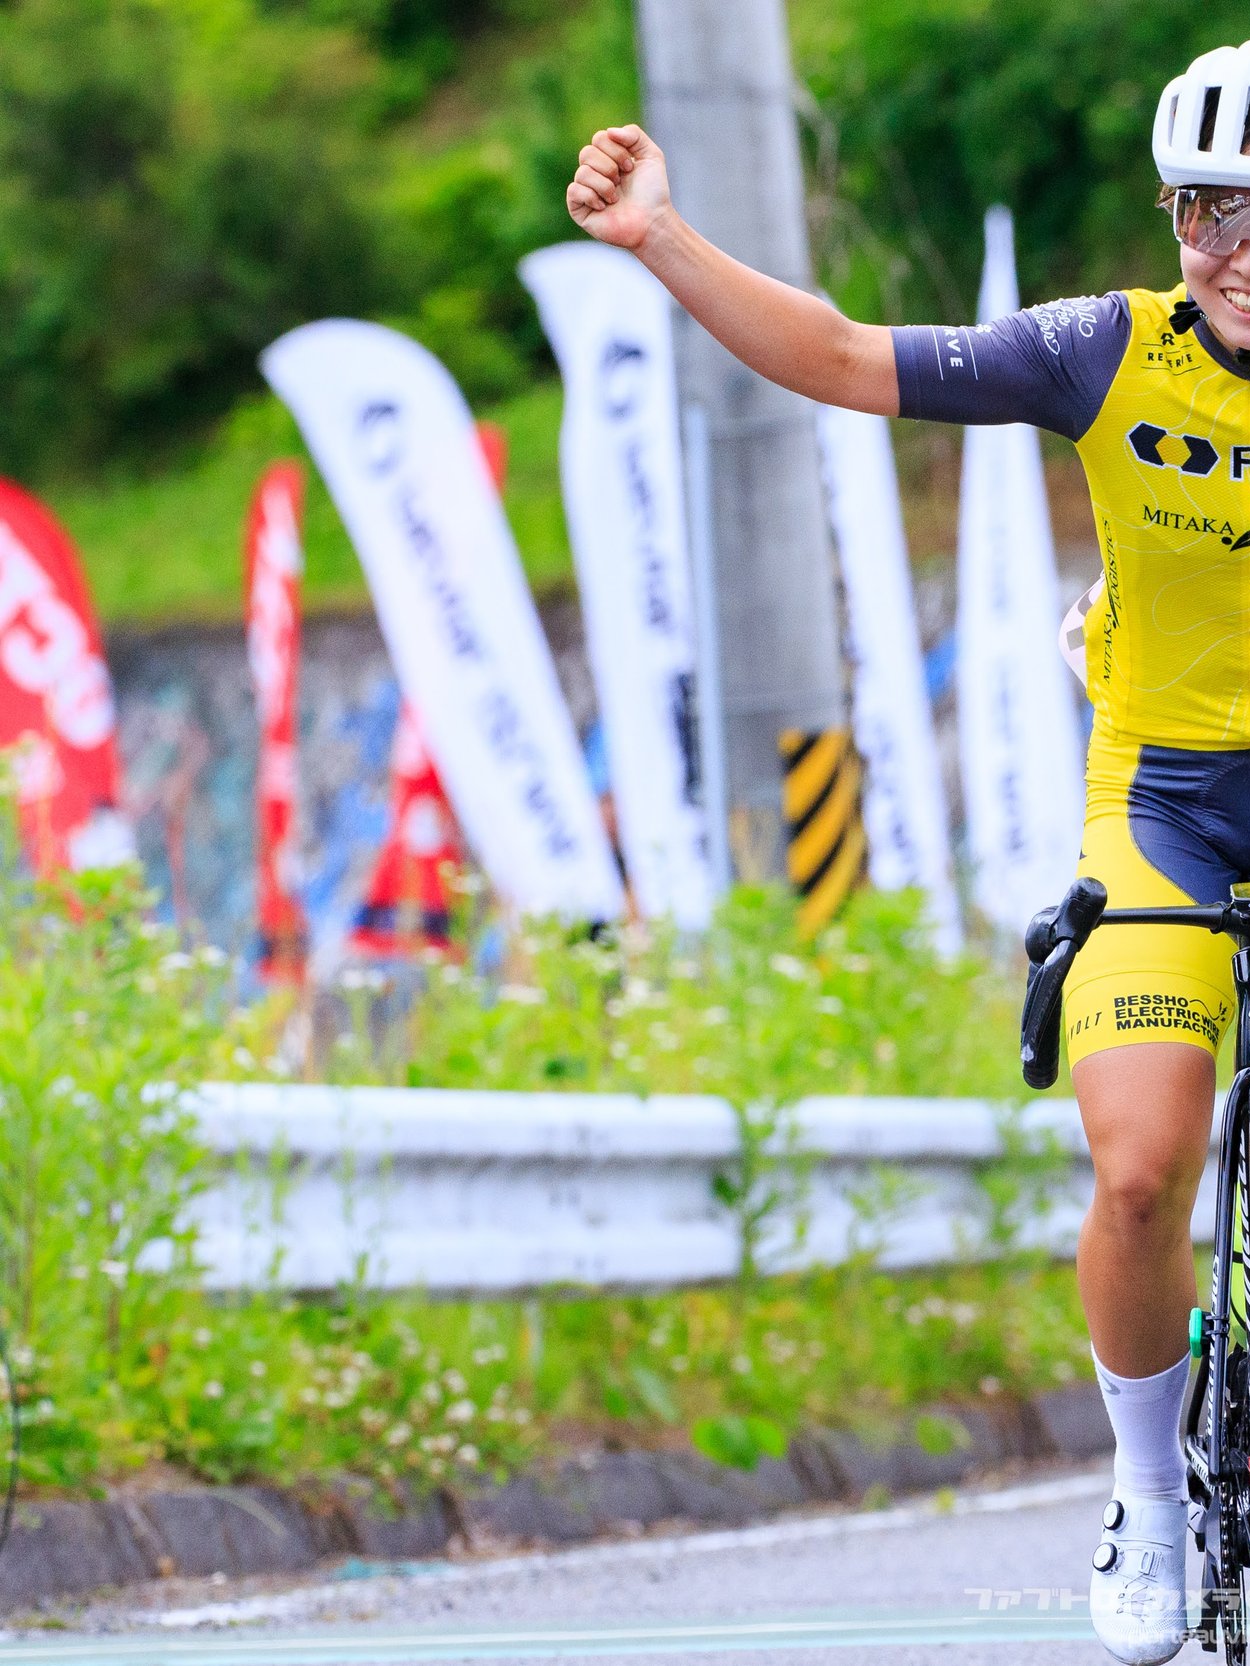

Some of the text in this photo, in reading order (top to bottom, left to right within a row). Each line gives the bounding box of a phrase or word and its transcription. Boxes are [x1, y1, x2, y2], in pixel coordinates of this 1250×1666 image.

[1142, 504, 1236, 536] MITAKA
[1103, 613, 1113, 684] MITAKA
[1114, 994, 1189, 1009] BESSHO
[1115, 1006, 1220, 1040] ELECTRIC WIRE
